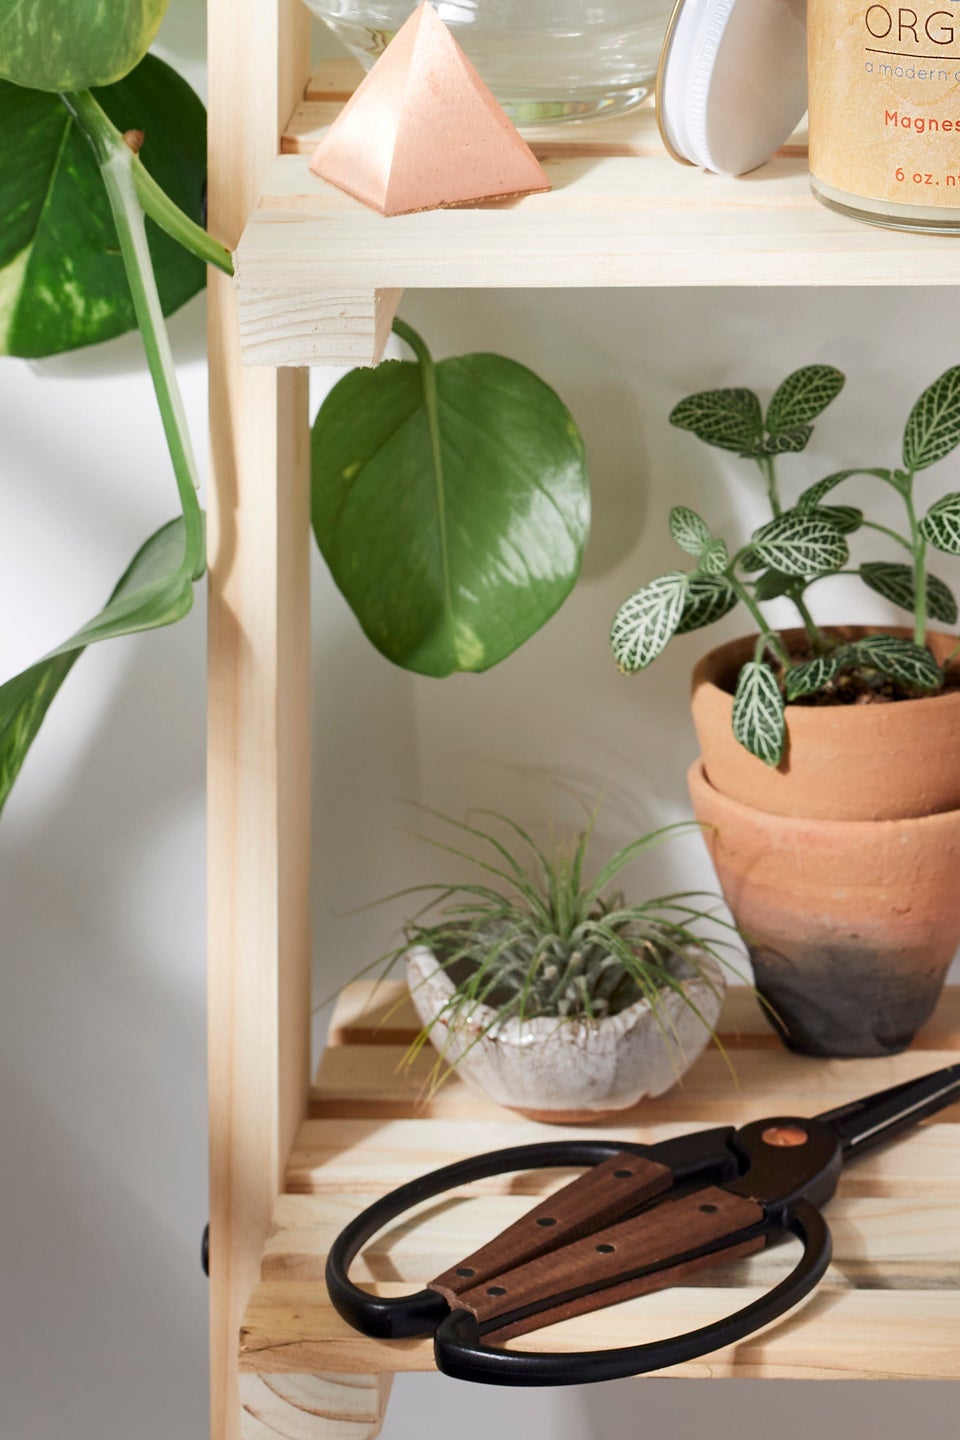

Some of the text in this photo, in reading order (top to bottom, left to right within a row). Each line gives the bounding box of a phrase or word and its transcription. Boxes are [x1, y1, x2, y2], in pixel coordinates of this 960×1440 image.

[865, 61, 874, 74] a
[878, 63, 948, 81] modern
[895, 167, 905, 182] 6
[912, 173, 940, 186] oz.
